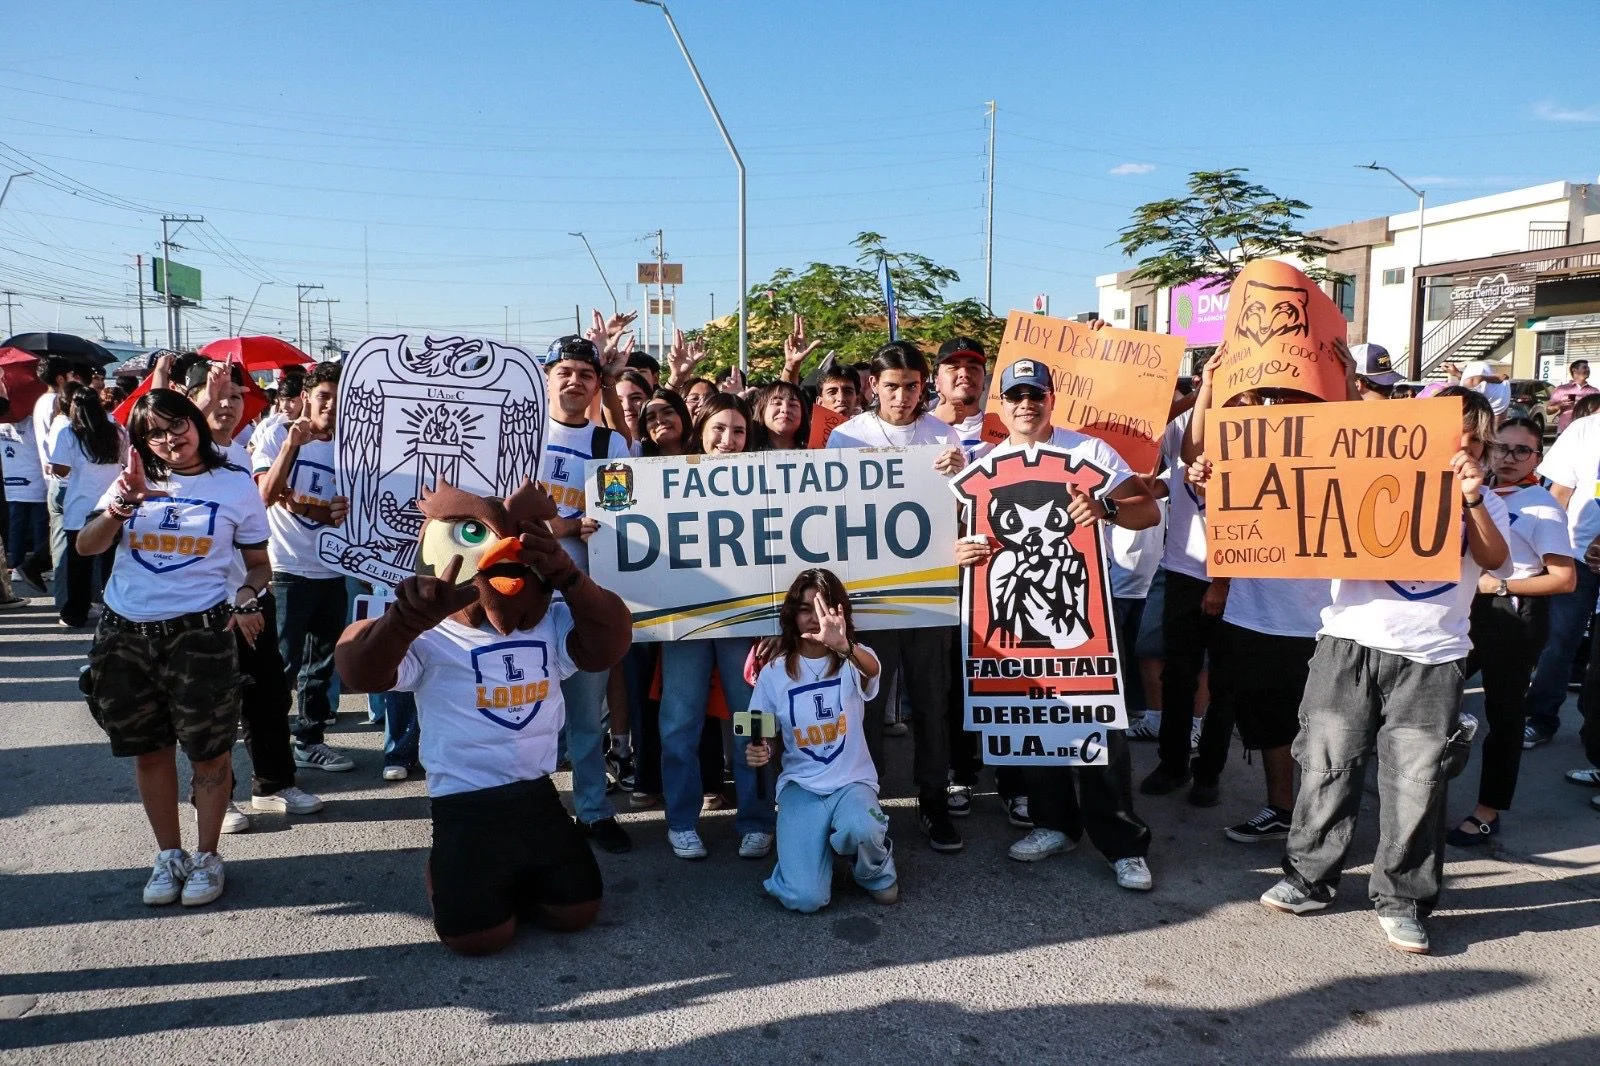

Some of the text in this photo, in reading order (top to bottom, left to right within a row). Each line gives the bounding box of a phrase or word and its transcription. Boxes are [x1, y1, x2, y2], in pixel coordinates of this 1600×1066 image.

[1501, 285, 1529, 297] Laguna
[1280, 343, 1318, 362] TODO
[1051, 364, 1094, 400] ÑANA
[1228, 360, 1300, 388] mejor
[1543, 360, 1551, 381] DOS
[1067, 399, 1153, 440] LIDERAMOS
[1330, 424, 1427, 460] AMIGO
[551, 456, 570, 482] L
[662, 458, 905, 499] FACULTAD DE
[1218, 463, 1454, 558] LA FACU
[616, 501, 932, 572] DERECHO
[1211, 519, 1263, 541] ESTÁ
[128, 531, 214, 558] LOBOS
[325, 540, 343, 554] EN
[1214, 546, 1286, 565] CONTIGO!
[365, 563, 379, 575] EL
[502, 654, 524, 682] L
[965, 657, 1118, 677] FACULTAD
[476, 680, 549, 709] LOBOS
[1028, 686, 1058, 700] DE
[813, 694, 834, 720] L
[972, 704, 1116, 724] DERECHO
